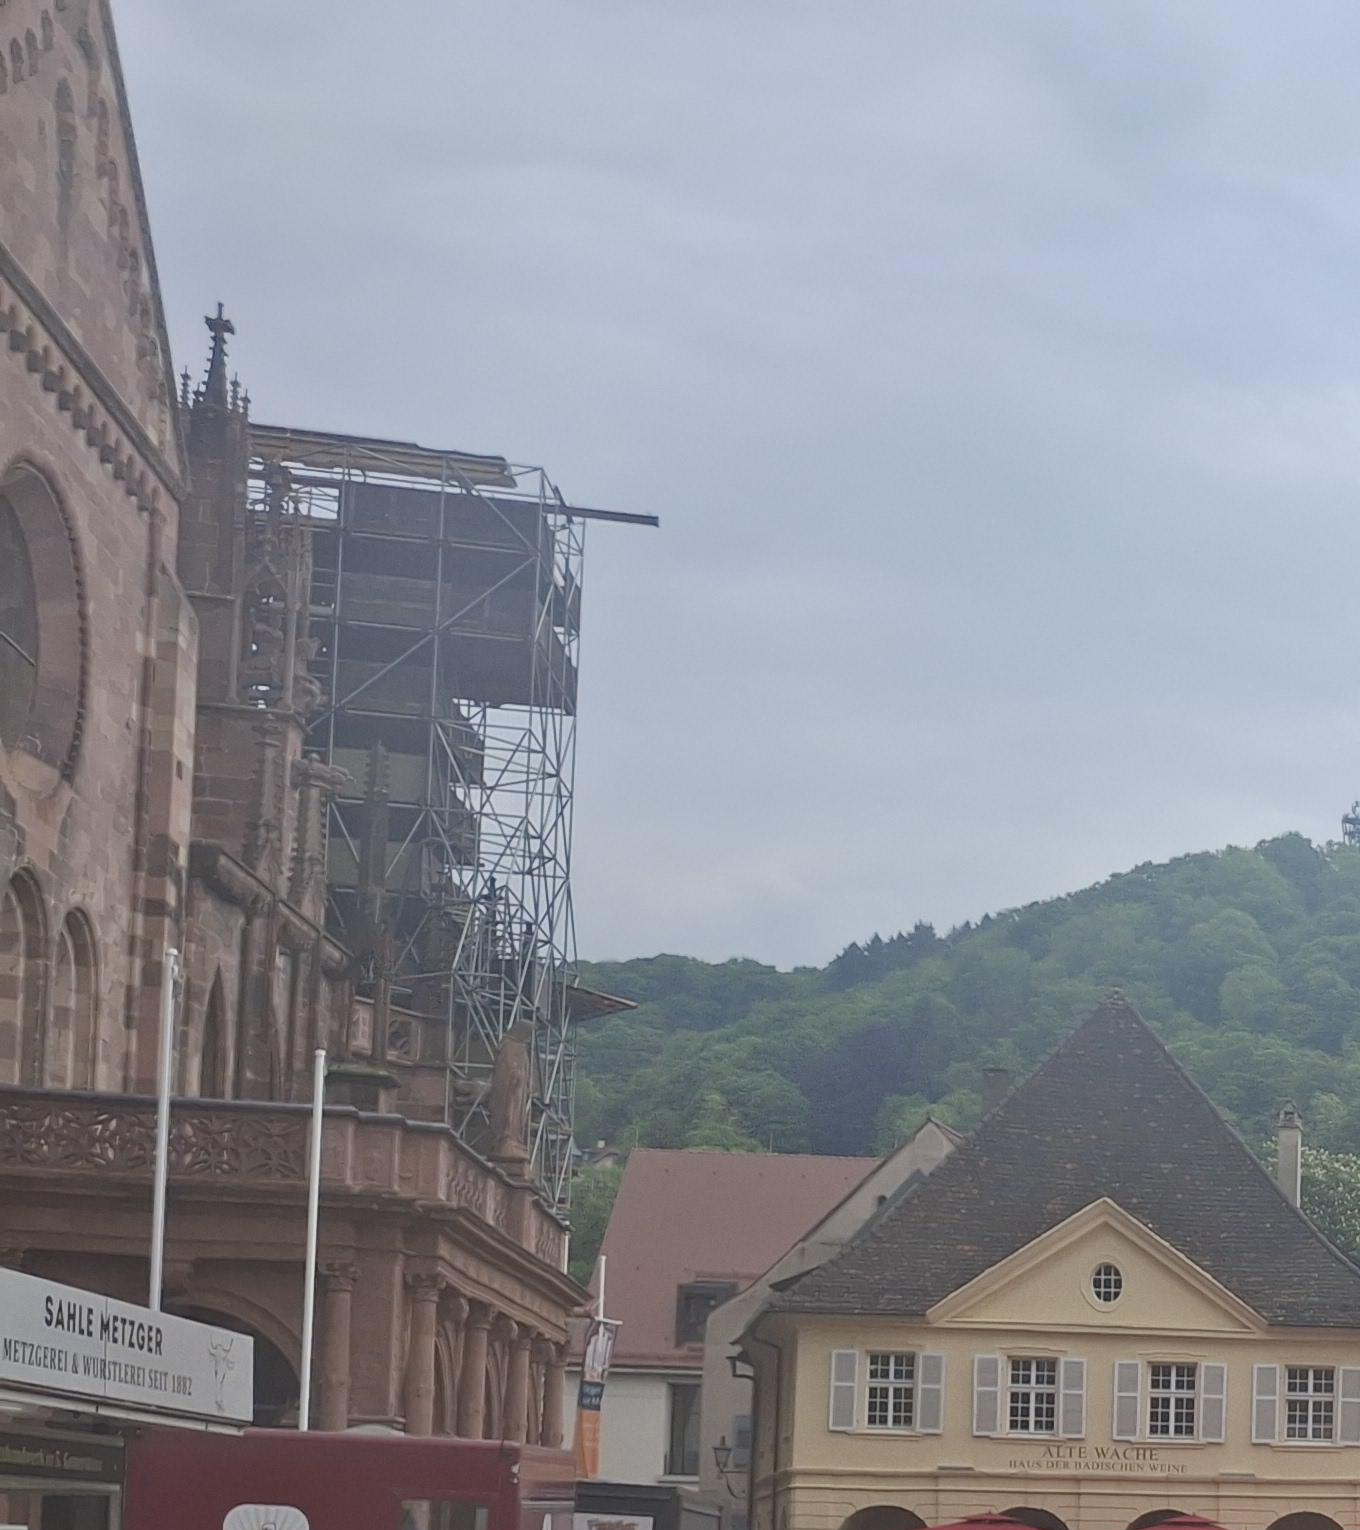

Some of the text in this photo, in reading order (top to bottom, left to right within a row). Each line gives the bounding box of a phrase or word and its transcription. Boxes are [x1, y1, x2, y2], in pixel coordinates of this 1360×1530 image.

[44, 1295, 163, 1356] SAHLE METZGER
[2, 1337, 68, 1373] METZGEREI
[72, 1355, 79, 1374] &
[149, 1368, 169, 1393] SEIT
[172, 1374, 193, 1396] 1882
[1009, 1459, 1188, 1473] HAUS DER BADISCHEN WEINE
[1042, 1446, 1160, 1461] ALTE WACHE
